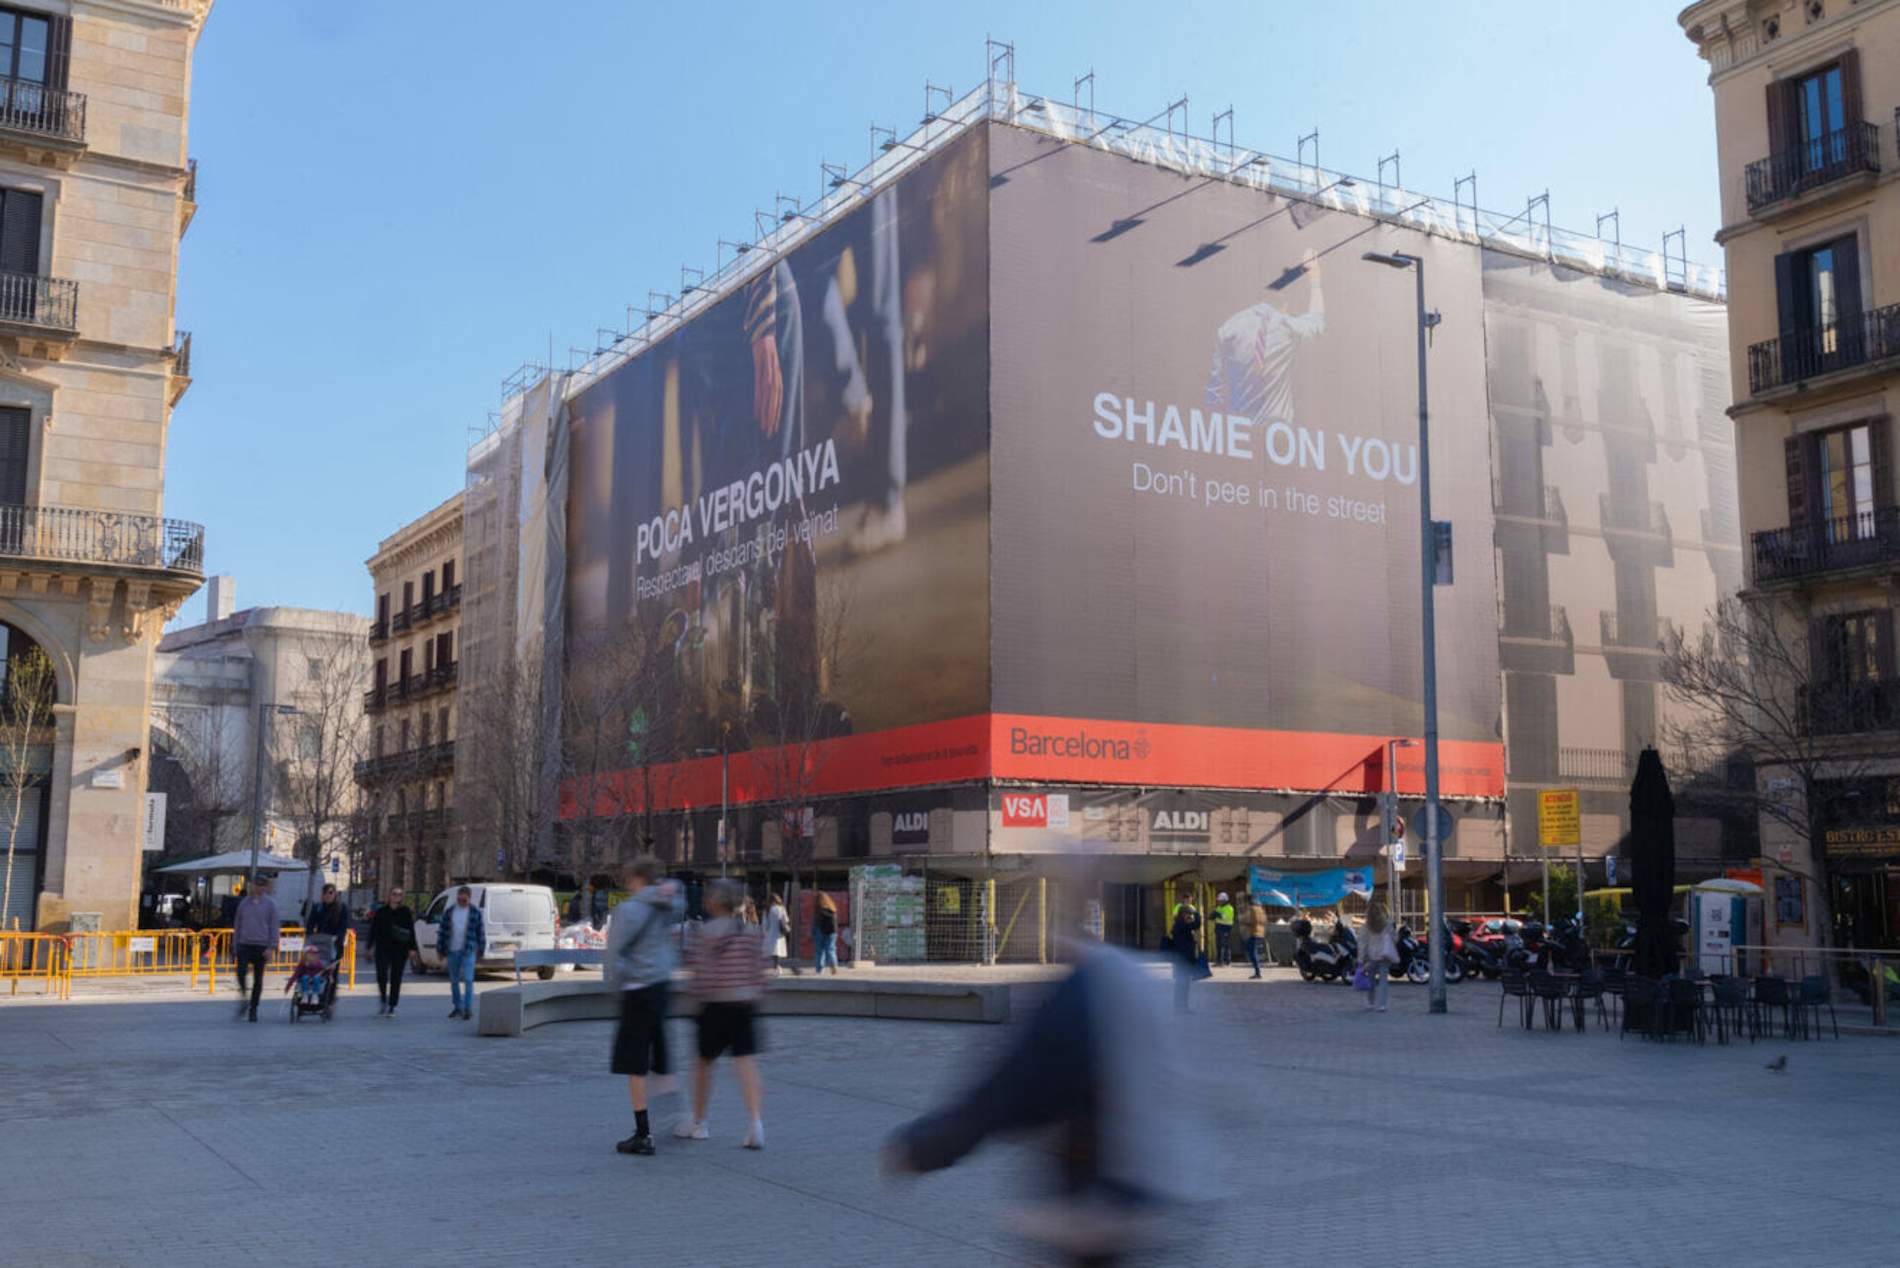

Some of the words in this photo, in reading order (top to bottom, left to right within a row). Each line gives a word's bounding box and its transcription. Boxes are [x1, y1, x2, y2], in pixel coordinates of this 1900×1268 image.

[1093, 392, 1253, 460] SHAME
[1266, 422, 1326, 471] ON
[1337, 433, 1417, 485] YOU
[637, 504, 693, 564] POCA
[700, 438, 840, 538] VERGONYA
[1133, 462, 1197, 498] Don't
[1206, 480, 1250, 507] pee
[1259, 482, 1277, 509] in
[1286, 487, 1319, 514] the
[1328, 496, 1386, 524] street
[706, 539, 761, 576] descans
[1011, 727, 1130, 760] Barcelona
[894, 812, 929, 832] ALDI
[1005, 797, 1045, 818] VSA
[1153, 811, 1208, 830] ALDI
